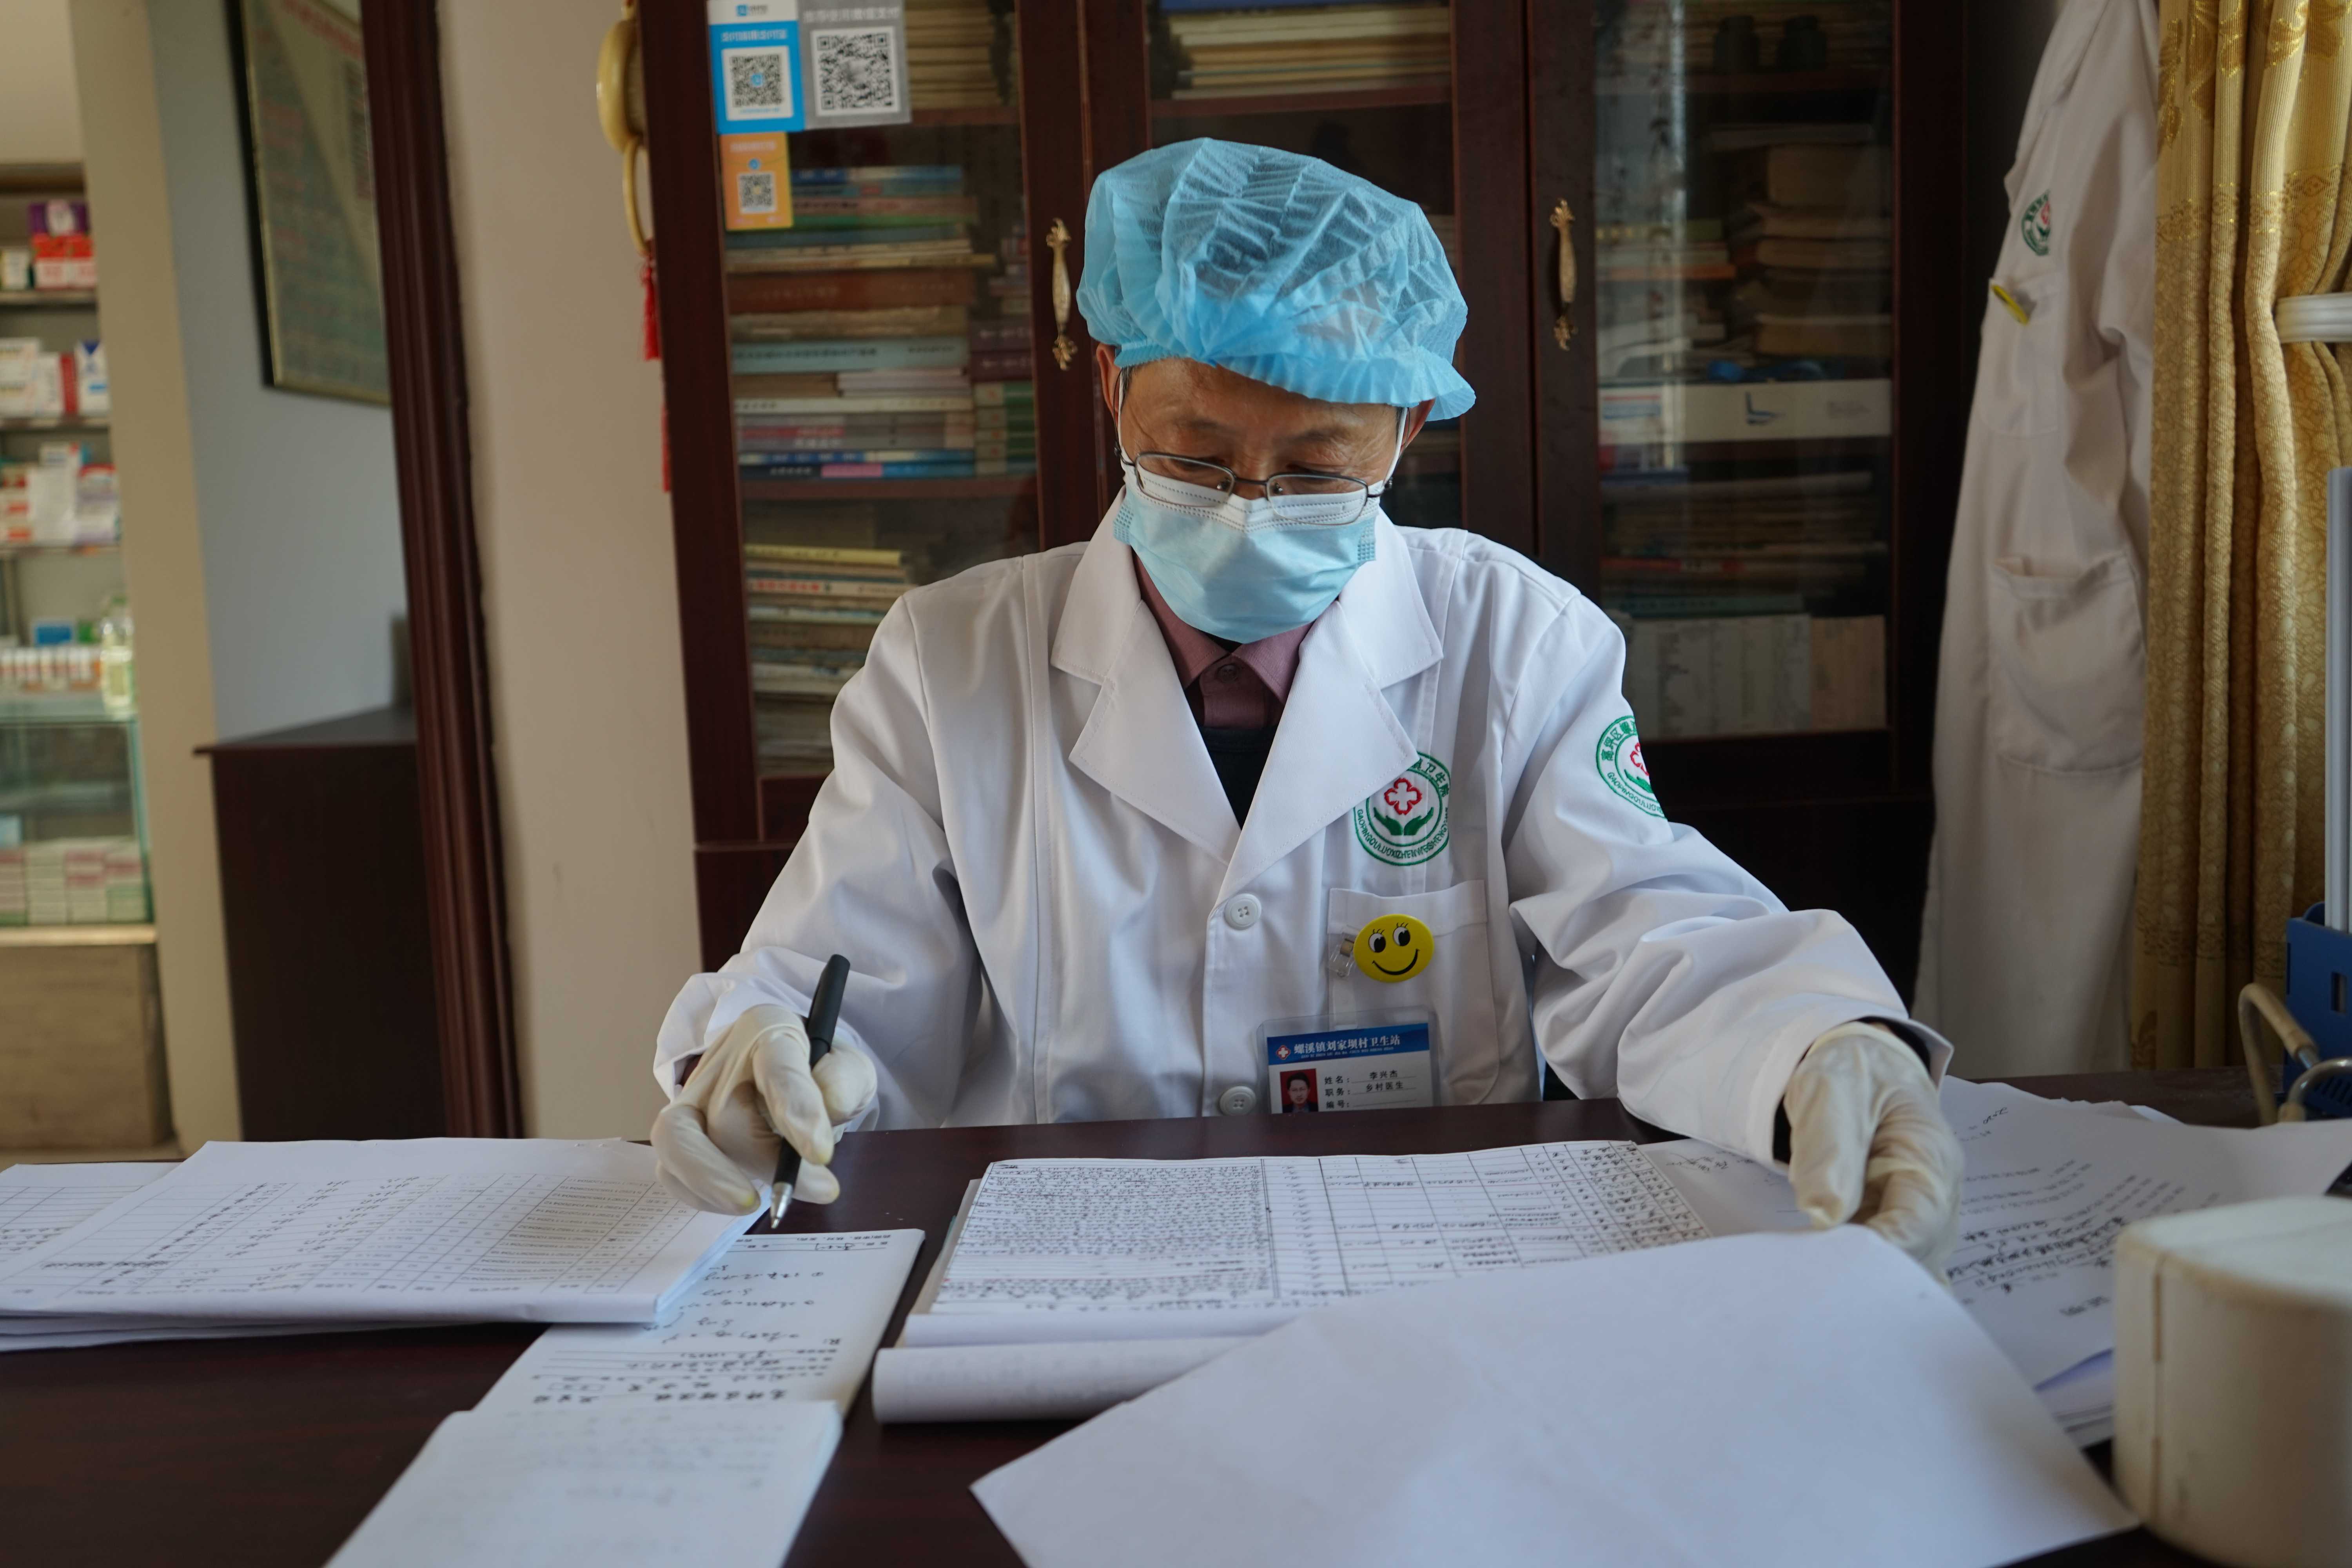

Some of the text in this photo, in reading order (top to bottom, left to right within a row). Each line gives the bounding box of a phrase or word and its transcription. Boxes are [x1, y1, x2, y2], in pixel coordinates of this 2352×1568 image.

[1294, 1034, 1400, 1054] 螺溪镇刘家坝村卫生站
[1325, 1075, 1349, 1085] 姓名：
[1325, 1081, 1403, 1096] 职务： 乡村医生
[1326, 1100, 1349, 1109] 编号：
